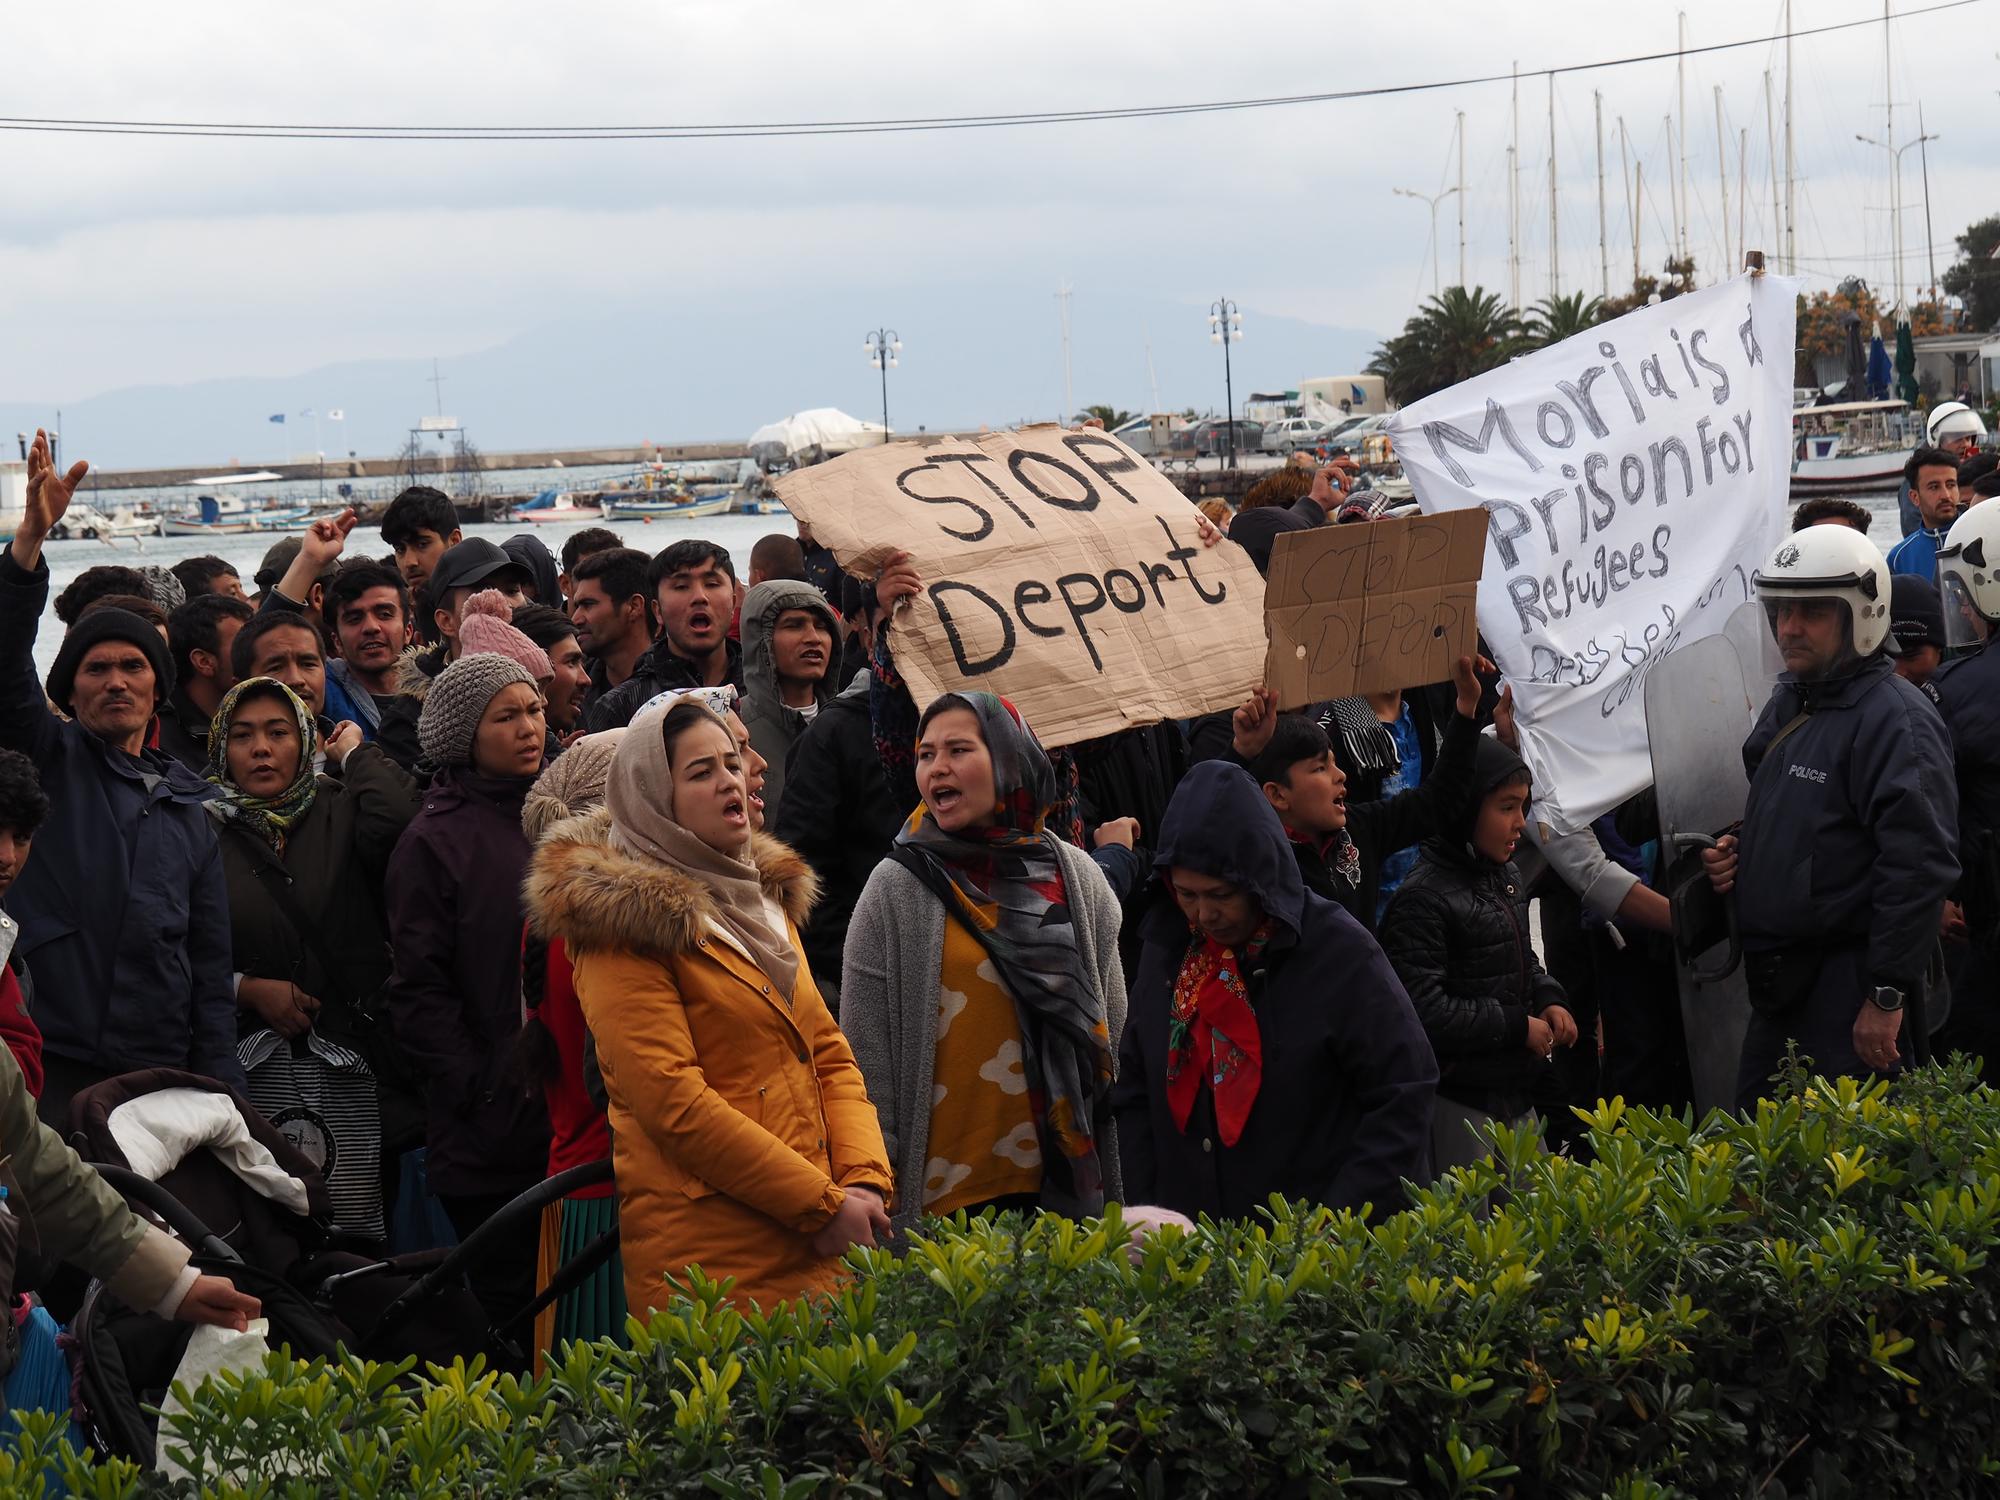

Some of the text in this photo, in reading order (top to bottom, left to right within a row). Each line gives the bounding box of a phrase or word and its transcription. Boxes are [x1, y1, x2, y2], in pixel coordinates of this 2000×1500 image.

[1422, 341, 1677, 487] Moria
[1669, 328, 1731, 405] is
[896, 435, 1140, 542] STOP
[928, 515, 1227, 677] Deport
[1507, 523, 1672, 635] Refugees
[1788, 764, 1827, 784] POLICE
